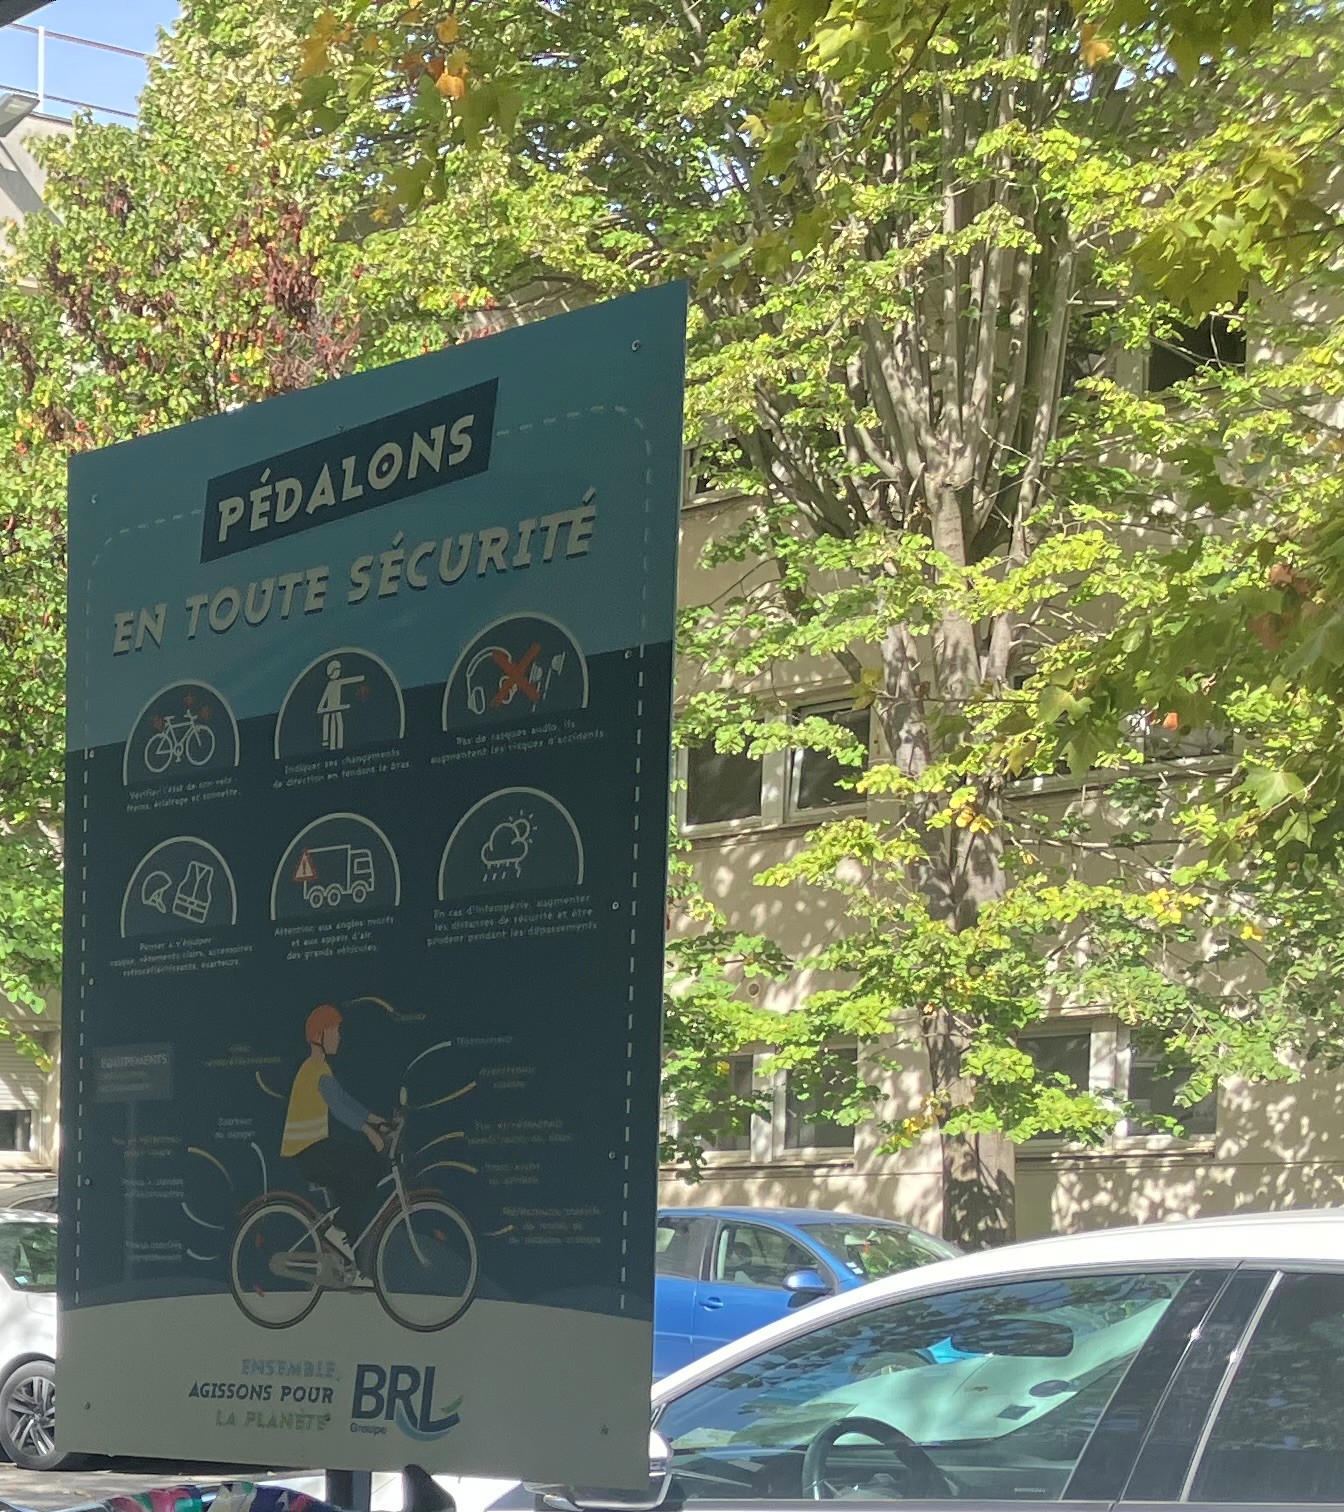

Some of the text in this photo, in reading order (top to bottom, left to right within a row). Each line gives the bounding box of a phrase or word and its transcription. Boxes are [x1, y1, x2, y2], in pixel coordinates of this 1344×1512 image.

[218, 414, 474, 542] PÉDALONS
[112, 487, 597, 656] EN TOUTE SÉCURITÉ
[188, 1381, 334, 1404] AGISSONS POUR
[351, 1363, 461, 1434] BRL
[215, 1409, 236, 1427] LA
[350, 1422, 387, 1436] Groupe
